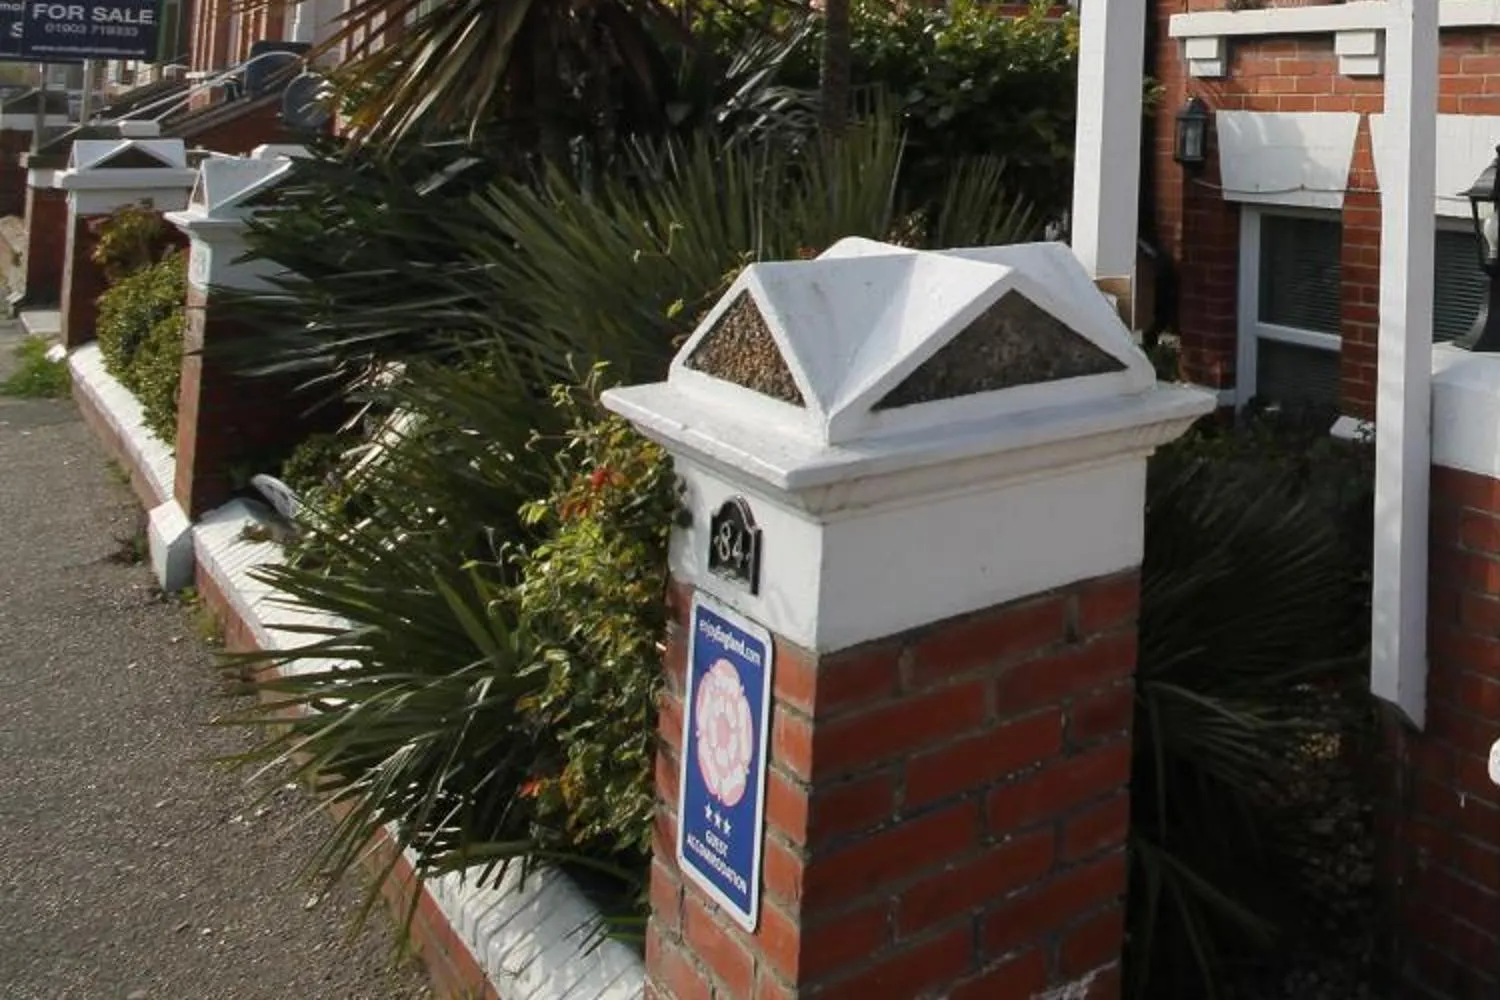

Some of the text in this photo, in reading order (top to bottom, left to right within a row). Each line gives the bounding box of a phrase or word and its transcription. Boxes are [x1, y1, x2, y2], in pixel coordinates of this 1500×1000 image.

[32, 3, 153, 24] FOR SALE
[719, 519, 743, 569] 84
